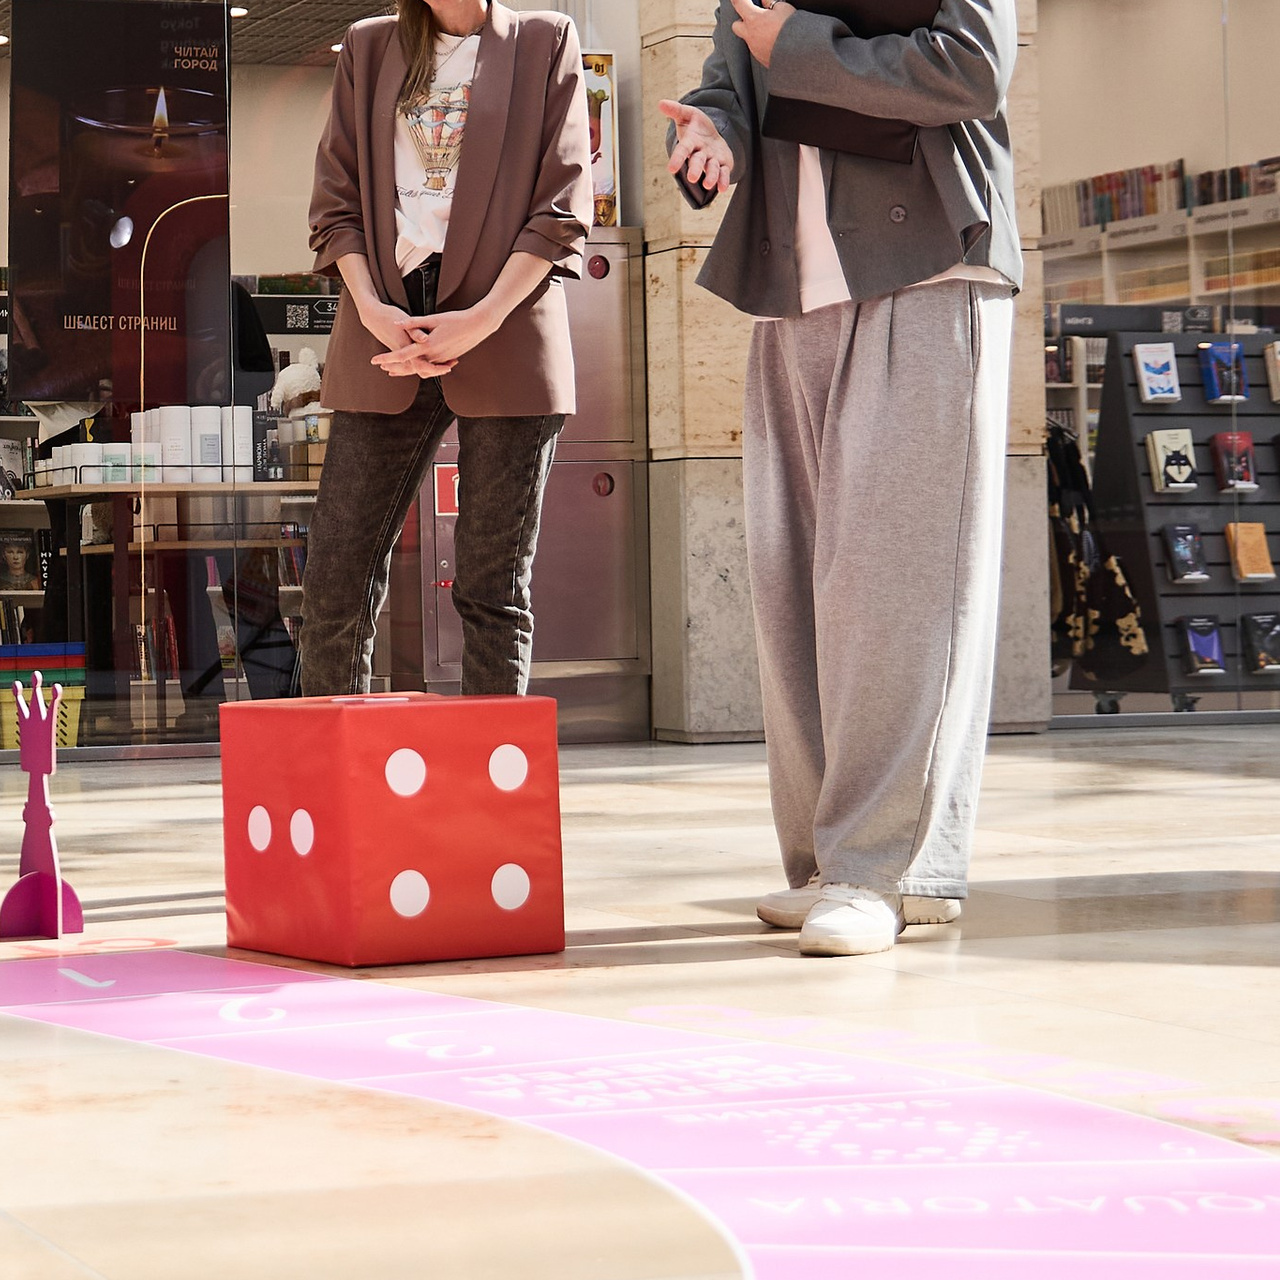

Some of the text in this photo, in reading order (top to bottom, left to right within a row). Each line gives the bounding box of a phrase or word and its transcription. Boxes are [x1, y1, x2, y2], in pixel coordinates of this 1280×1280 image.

[174, 45, 218, 57] ЧИТАЙ
[174, 59, 218, 71] ГОРОД
[594, 63, 605, 73] 01
[63, 315, 177, 330] ШЕЛЕСТ СТРАНИЦ
[57, 968, 116, 988] 1
[195, 997, 287, 1022] 2
[385, 1028, 496, 1059] 3
[661, 1099, 952, 1122] ЗАДАНИЕ
